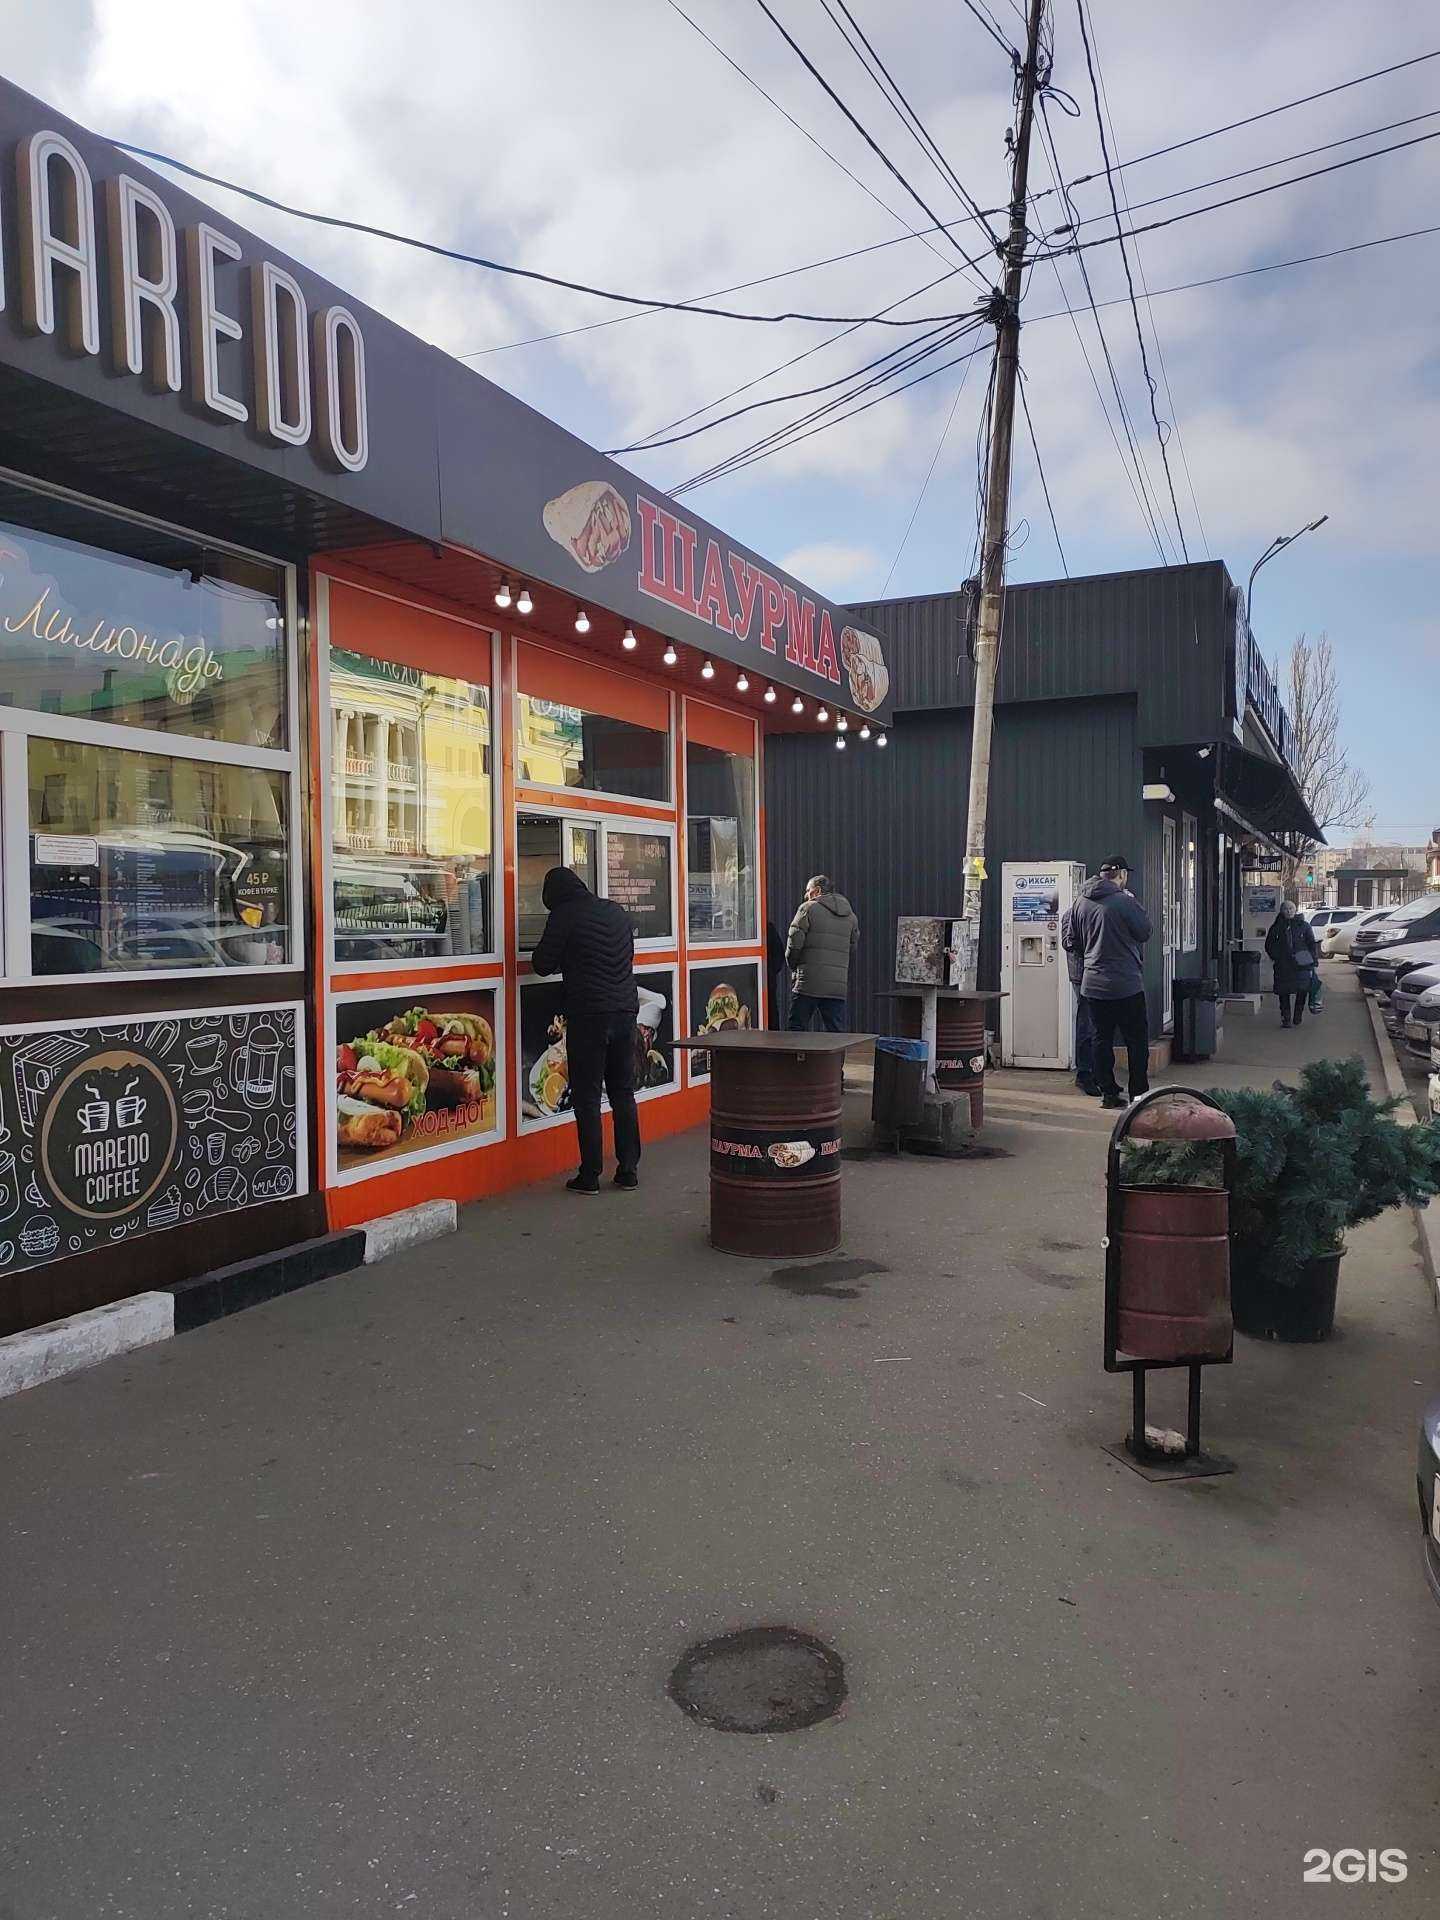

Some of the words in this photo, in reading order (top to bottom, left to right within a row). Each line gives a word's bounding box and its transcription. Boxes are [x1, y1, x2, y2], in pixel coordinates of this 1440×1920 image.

[0, 130, 368, 472] AREDO
[637, 494, 841, 684] ШАУРМА
[3, 586, 224, 693] Лимонады
[246, 873, 260, 885] 45
[1028, 877, 1056, 885] ИХСАН
[411, 1098, 488, 1139] ХОД-ДОГ
[75, 1132, 150, 1177] MAREDO
[86, 1167, 140, 1204] COFFEE
